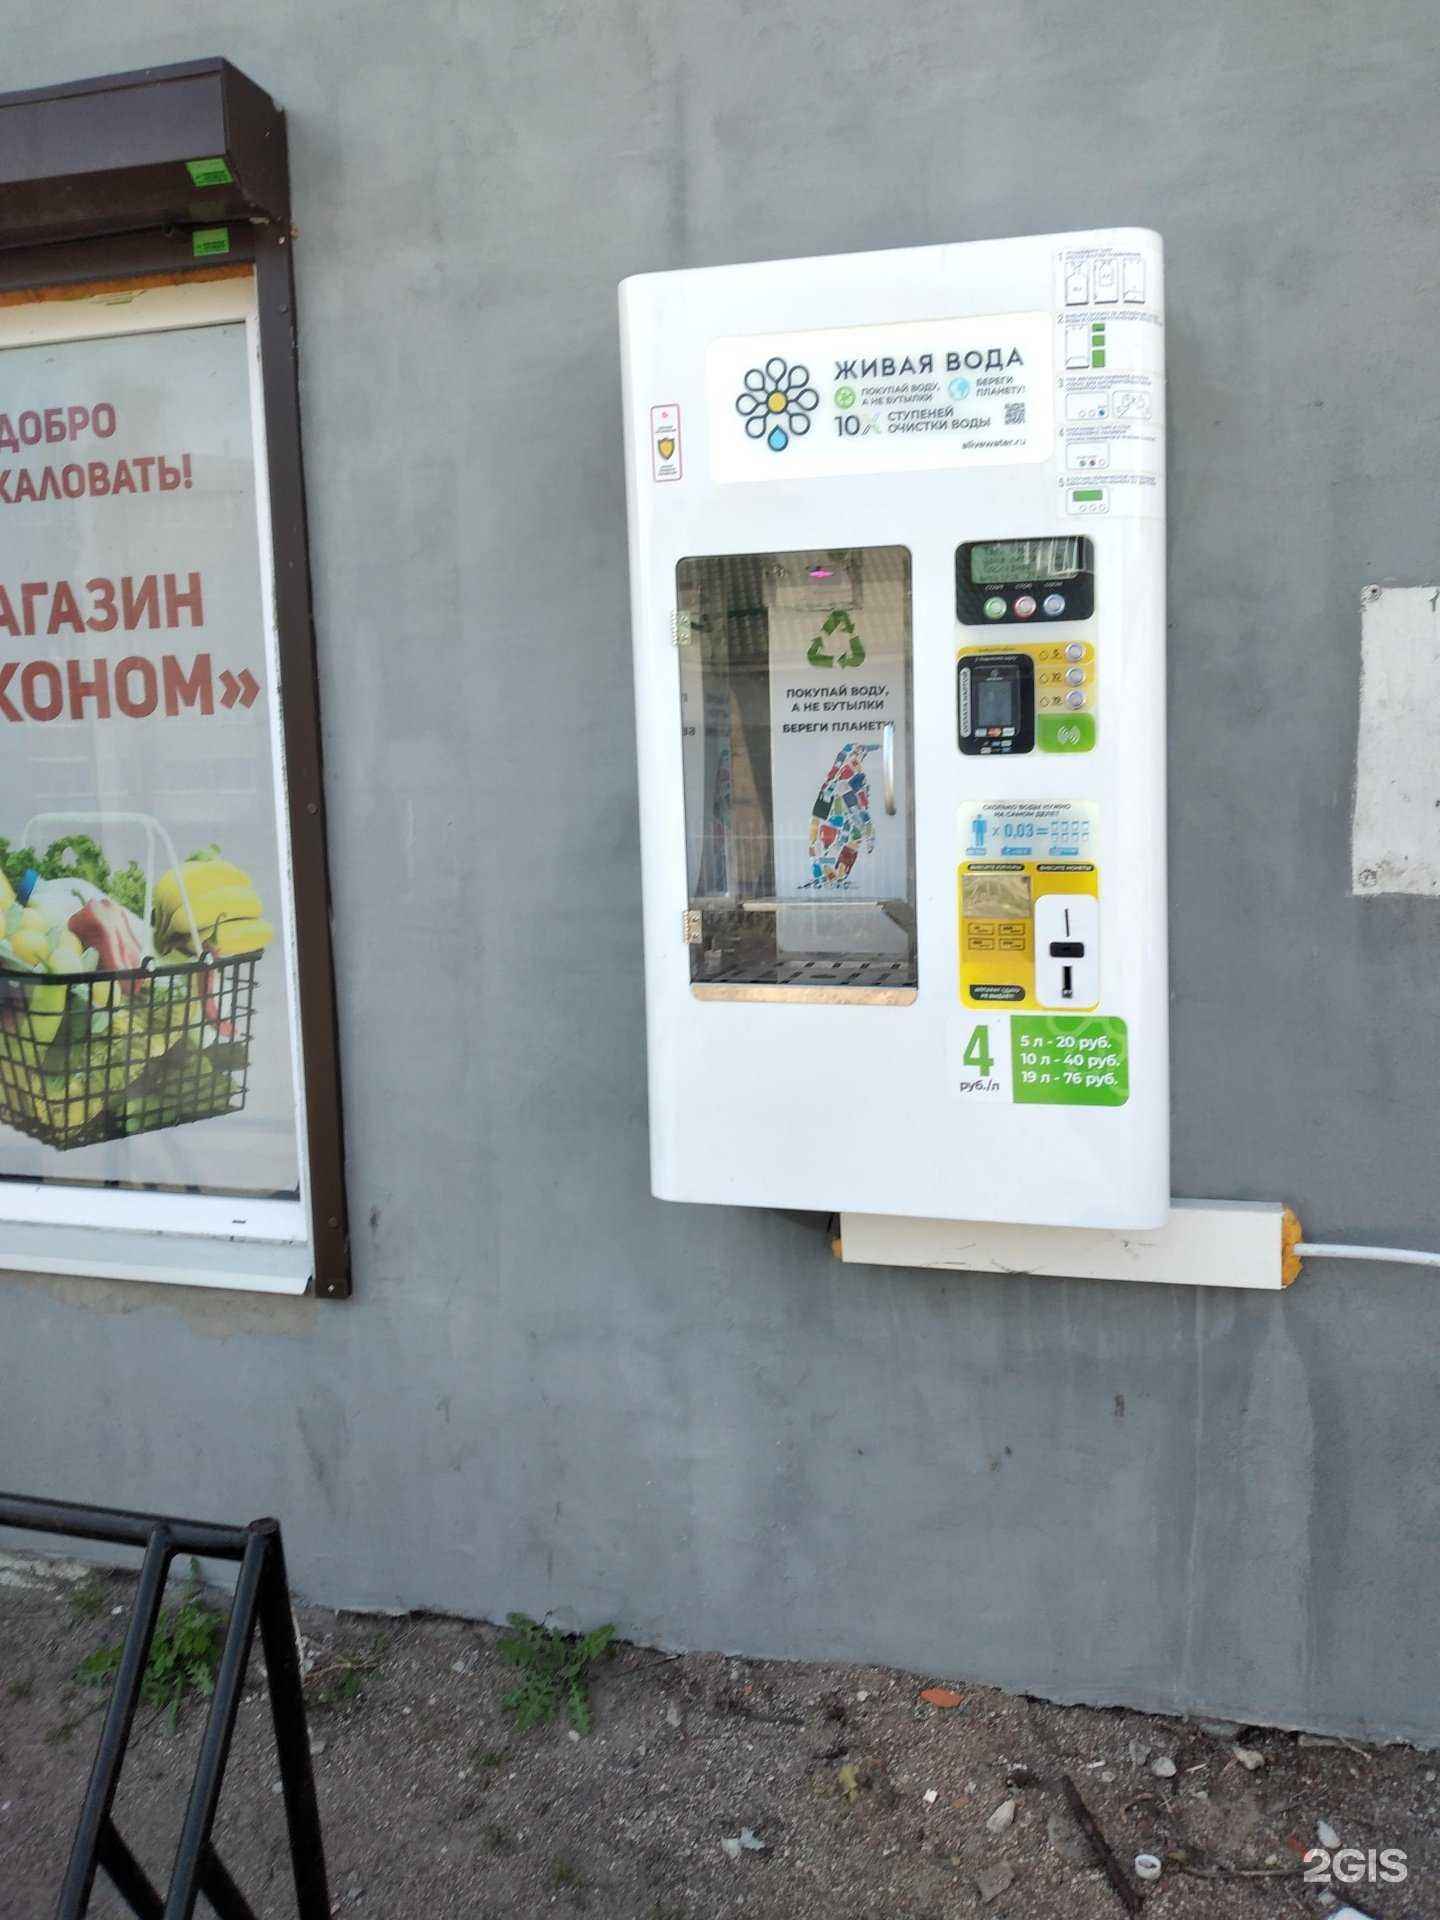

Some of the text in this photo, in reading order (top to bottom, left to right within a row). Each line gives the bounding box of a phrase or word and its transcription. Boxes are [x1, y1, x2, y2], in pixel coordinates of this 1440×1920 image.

[834, 347, 1024, 381] ЖИВАЯ ВОДА
[887, 405, 954, 422] СТУПЕНЕЙ
[0, 402, 117, 453] ДОБРО
[834, 415, 860, 437] 10
[888, 416, 991, 434] ОЧИСТКИ ВОДЫ
[786, 683, 889, 698] ПОКУПАЙ ВОДУ,
[791, 700, 884, 712] А НЕ БУТЫЛКИ
[782, 722, 829, 734] БЕРЕГИ
[963, 1024, 994, 1077] 4
[1020, 1035, 1029, 1047] 5
[1032, 1038, 1043, 1047] л
[1056, 1036, 1075, 1048] 20
[1079, 1036, 1112, 1050] руб.
[1020, 1053, 1036, 1065] 10
[1040, 1055, 1050, 1065] л
[1063, 1054, 1083, 1066] 40
[1088, 1054, 1121, 1069] руб.
[960, 1080, 1000, 1092] руб./л
[1021, 1071, 1036, 1083] 19
[1040, 1074, 1050, 1083] л
[1063, 1072, 1082, 1084] 76
[1086, 1072, 1118, 1087] руб.
